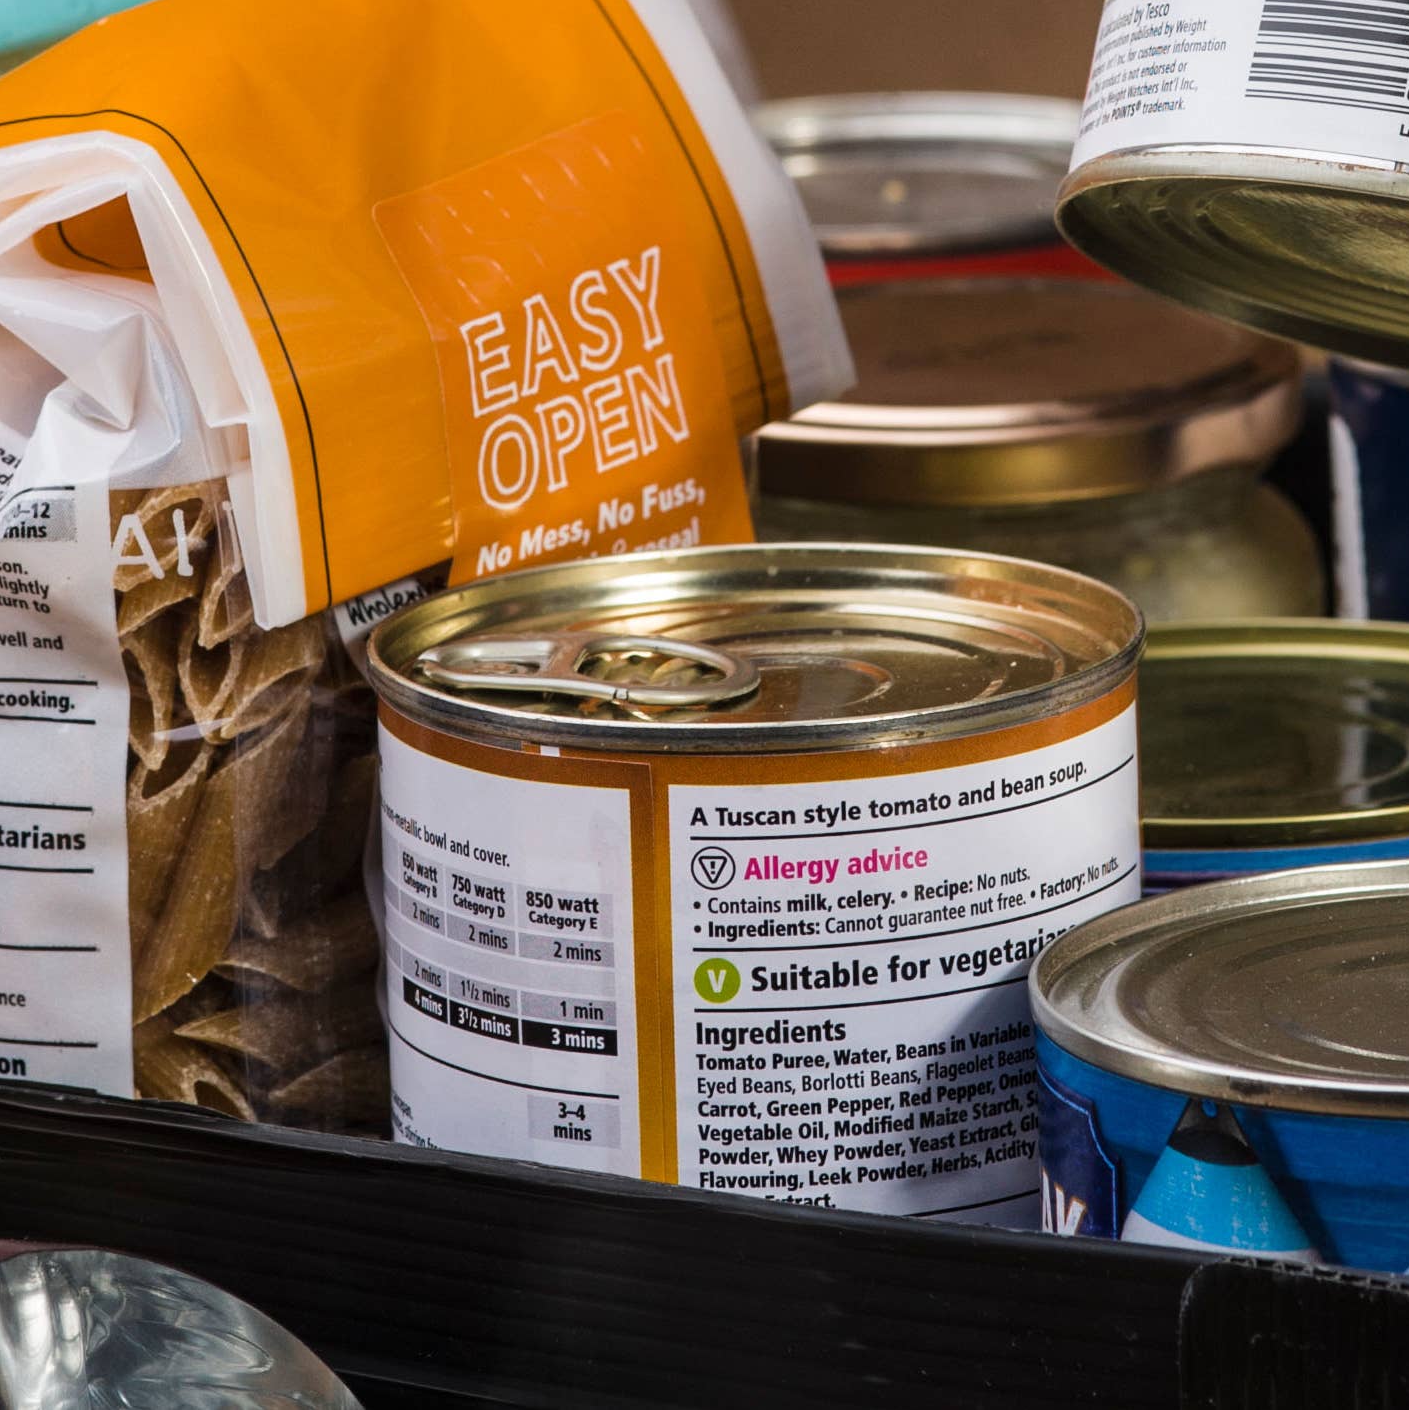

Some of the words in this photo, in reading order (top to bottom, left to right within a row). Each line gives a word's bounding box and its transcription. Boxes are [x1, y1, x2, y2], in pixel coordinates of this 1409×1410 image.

[460, 246, 664, 417] EASY
[478, 354, 689, 510] OPEN
[476, 542, 510, 576] No
[519, 520, 590, 560] Mess,
[598, 499, 634, 533] No
[643, 479, 706, 520] Fuss,
[32, 600, 50, 614] to
[32, 636, 63, 650] and
[691, 806, 708, 827] A
[718, 806, 796, 827] Tuscan
[803, 801, 861, 827] style
[868, 794, 951, 819] tomato
[958, 782, 995, 807] and
[1001, 773, 1044, 798] bean
[1049, 759, 1087, 790] soup.
[744, 851, 839, 884] Allergy
[847, 846, 928, 875] advice
[526, 891, 552, 909] 850
[558, 896, 599, 914] watt
[708, 897, 781, 915] Contains
[787, 892, 832, 912] milk,
[837, 891, 895, 912] celery.
[914, 879, 973, 904] Recipe:
[977, 874, 996, 892] No
[1000, 868, 1030, 885] nuts.
[529, 910, 587, 931] Category
[590, 918, 598, 929] E
[708, 920, 821, 942] Ingredients:
[825, 915, 883, 935] Cannot
[888, 904, 966, 934] guarantee
[970, 899, 993, 918] nut
[997, 892, 1026, 911] free.
[751, 962, 879, 992] Suitable
[889, 955, 930, 983] for
[552, 1028, 560, 1045] 3
[565, 1031, 605, 1050] mins
[696, 1020, 846, 1050] Ingredients
[697, 1053, 766, 1071] Tomato
[772, 1052, 829, 1070] Puree,
[833, 1048, 891, 1067] Water,
[896, 1040, 946, 1061] Beans
